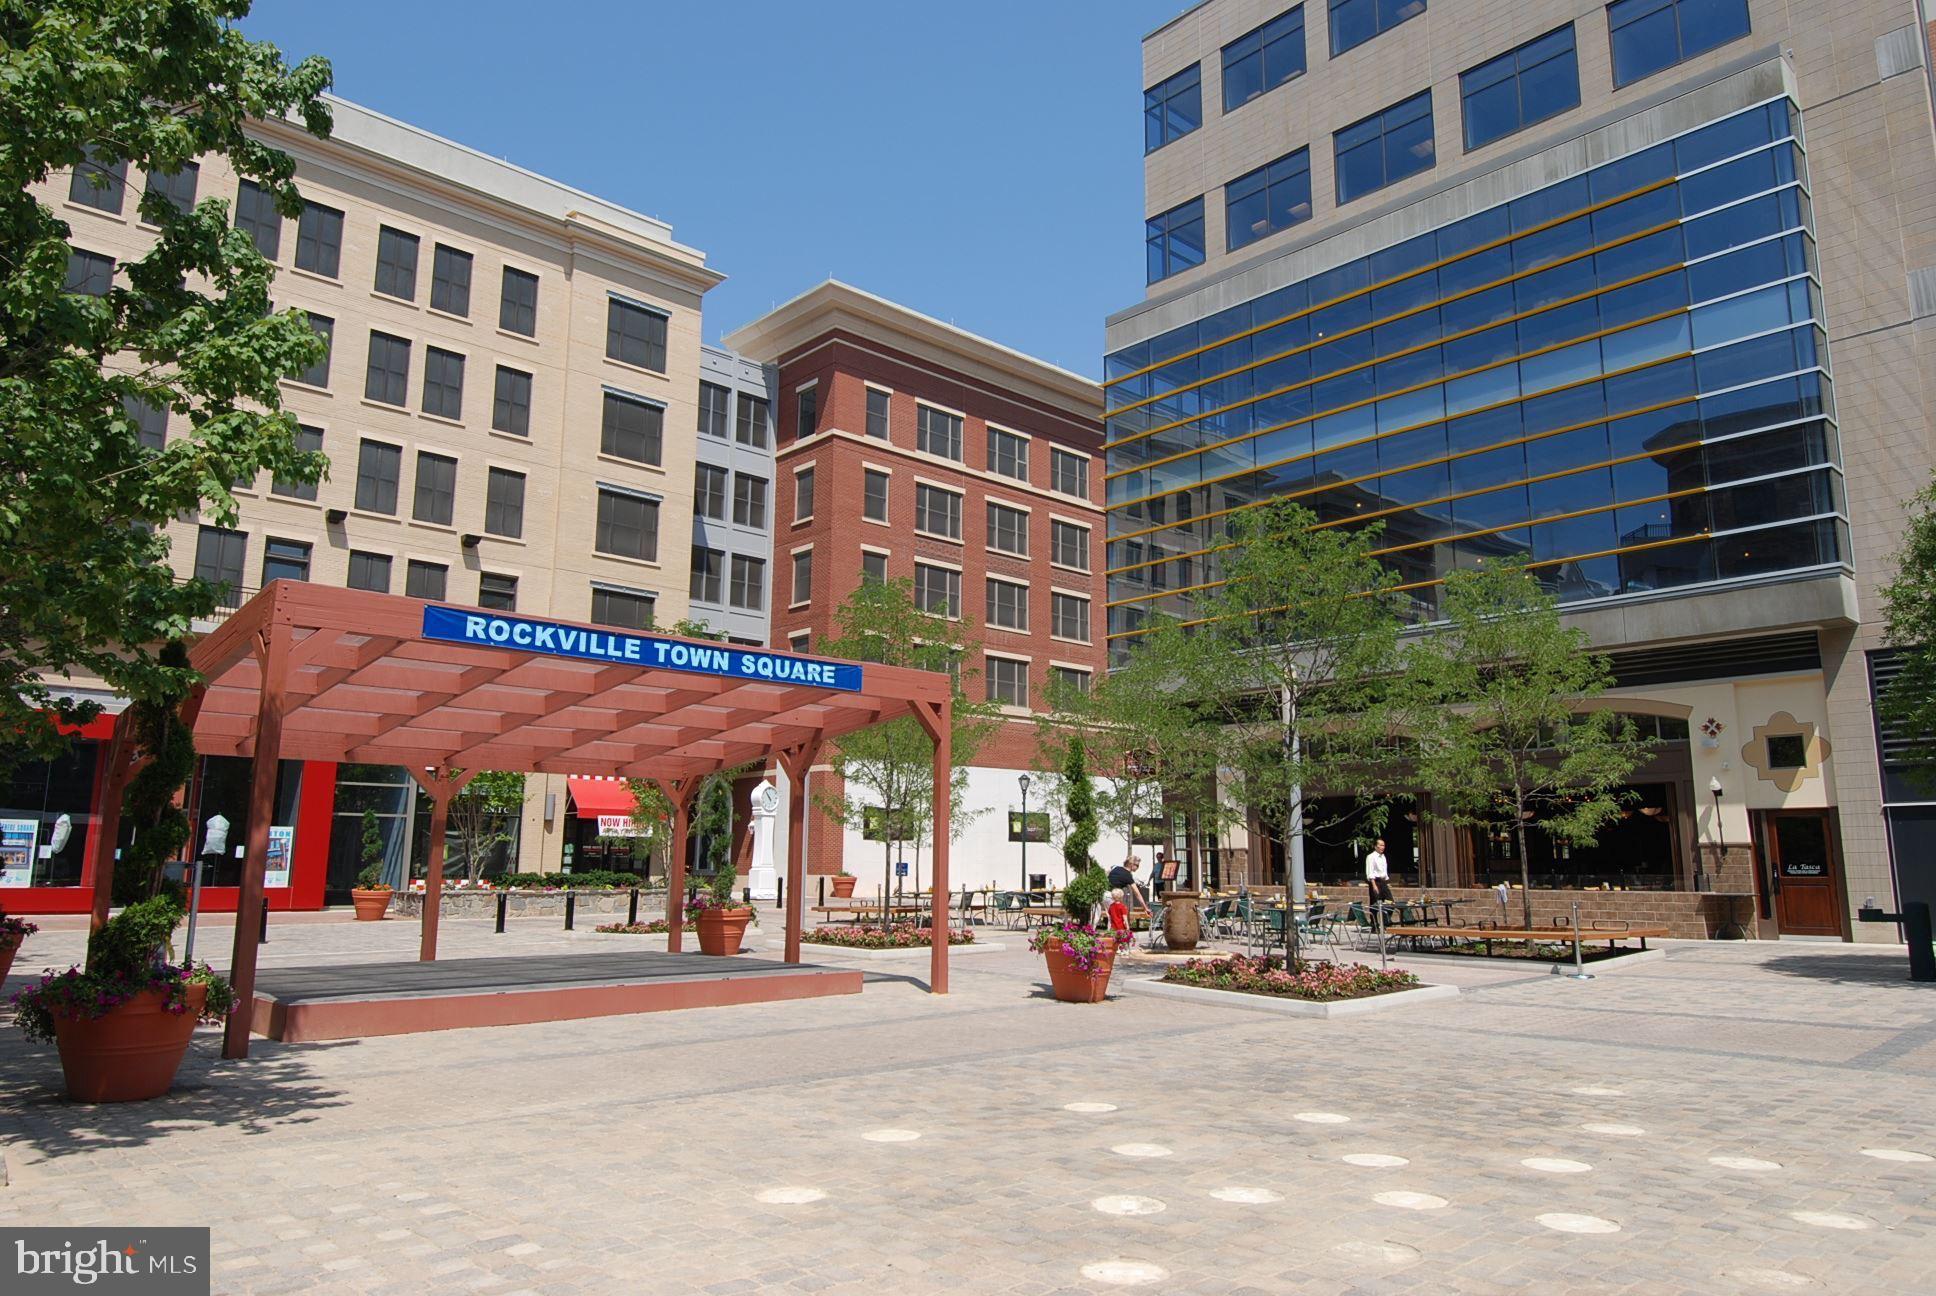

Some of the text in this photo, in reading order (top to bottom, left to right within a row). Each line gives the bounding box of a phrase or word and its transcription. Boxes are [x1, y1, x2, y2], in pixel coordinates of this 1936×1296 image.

[464, 615, 836, 684] ROCKVILLE TOWN SQUARE
[600, 818, 621, 828] NOW
